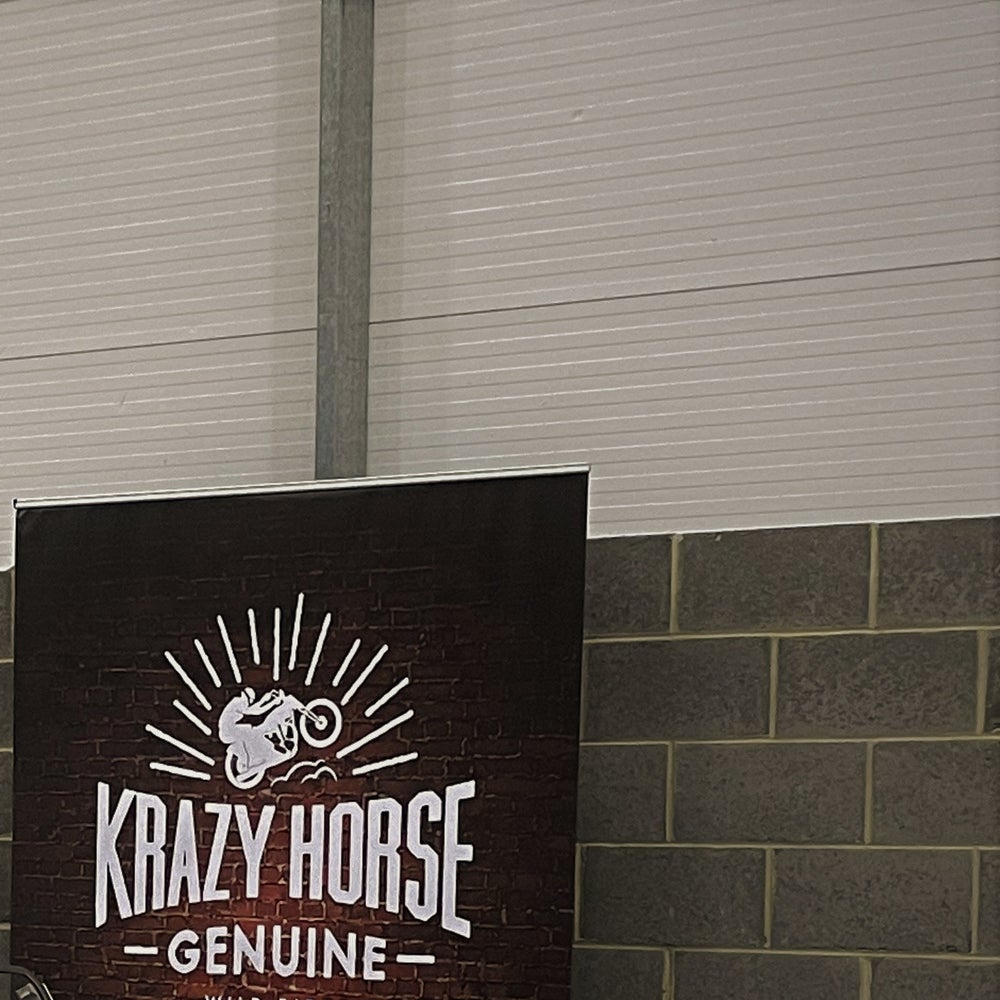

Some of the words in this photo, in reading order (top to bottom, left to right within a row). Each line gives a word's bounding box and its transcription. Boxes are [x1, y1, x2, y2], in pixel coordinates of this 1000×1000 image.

[95, 781, 276, 928] KRAZY
[289, 780, 476, 939] HORSE
[167, 923, 387, 981] GENUINE
